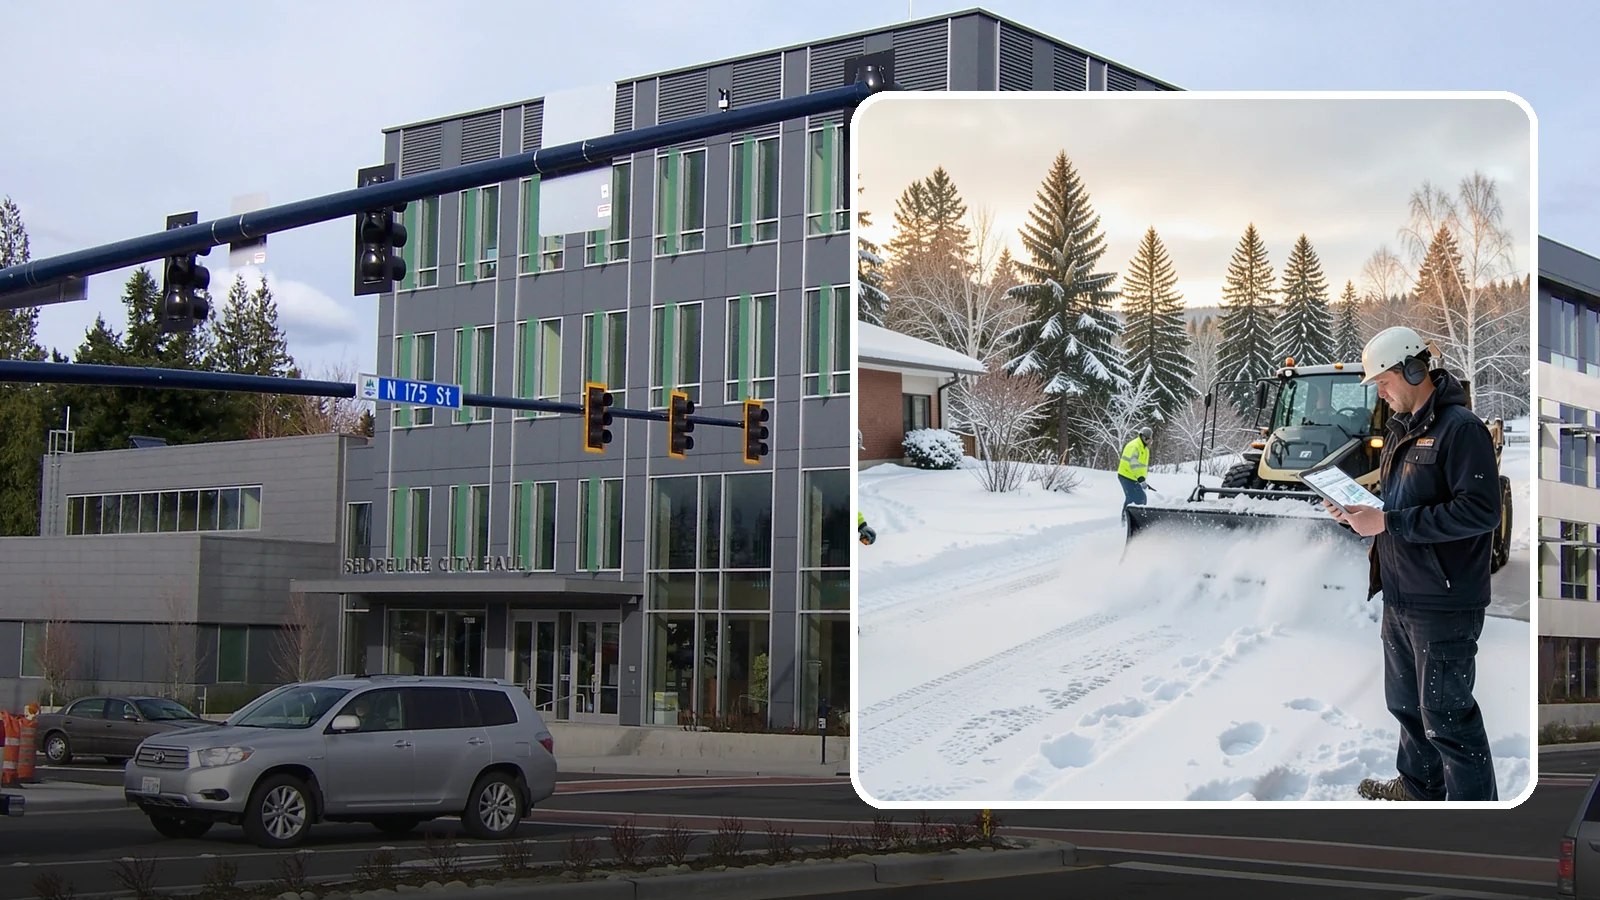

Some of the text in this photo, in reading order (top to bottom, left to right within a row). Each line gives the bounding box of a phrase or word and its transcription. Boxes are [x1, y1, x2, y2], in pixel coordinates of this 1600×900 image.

[387, 380, 452, 406] N 175 St
[343, 555, 526, 574] SHORELINE CITY HALL
